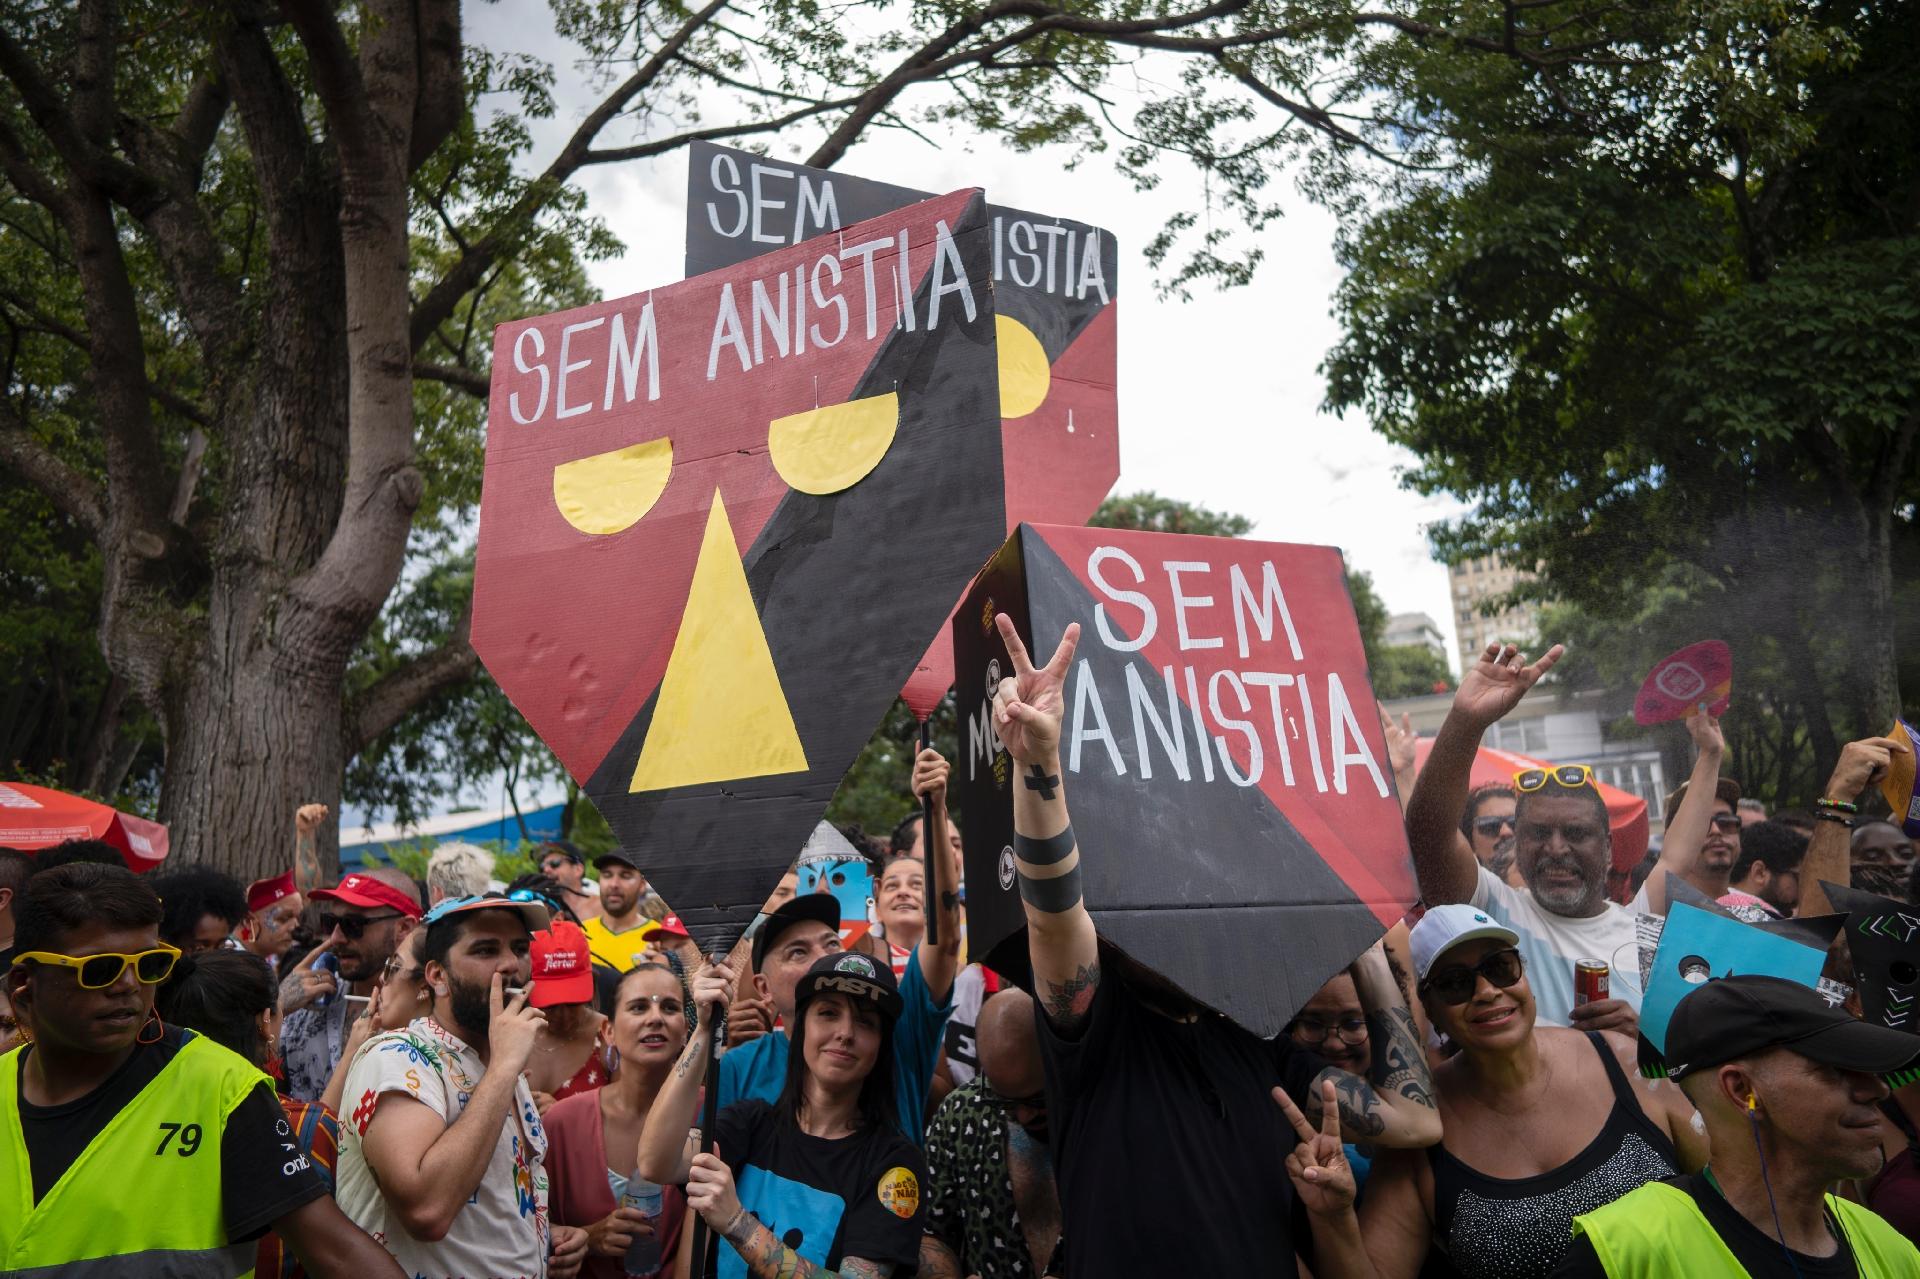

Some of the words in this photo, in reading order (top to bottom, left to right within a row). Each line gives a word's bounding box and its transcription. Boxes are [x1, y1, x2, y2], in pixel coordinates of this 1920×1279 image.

[707, 153, 841, 244] SEM
[992, 216, 1110, 305] ISTIA
[510, 299, 662, 425] SEM
[707, 219, 977, 381] ANISTIA
[1087, 545, 1304, 661] SEM
[1068, 658, 1391, 798] ANISTIA
[814, 976, 889, 1001] MST
[155, 1122, 203, 1157] 79
